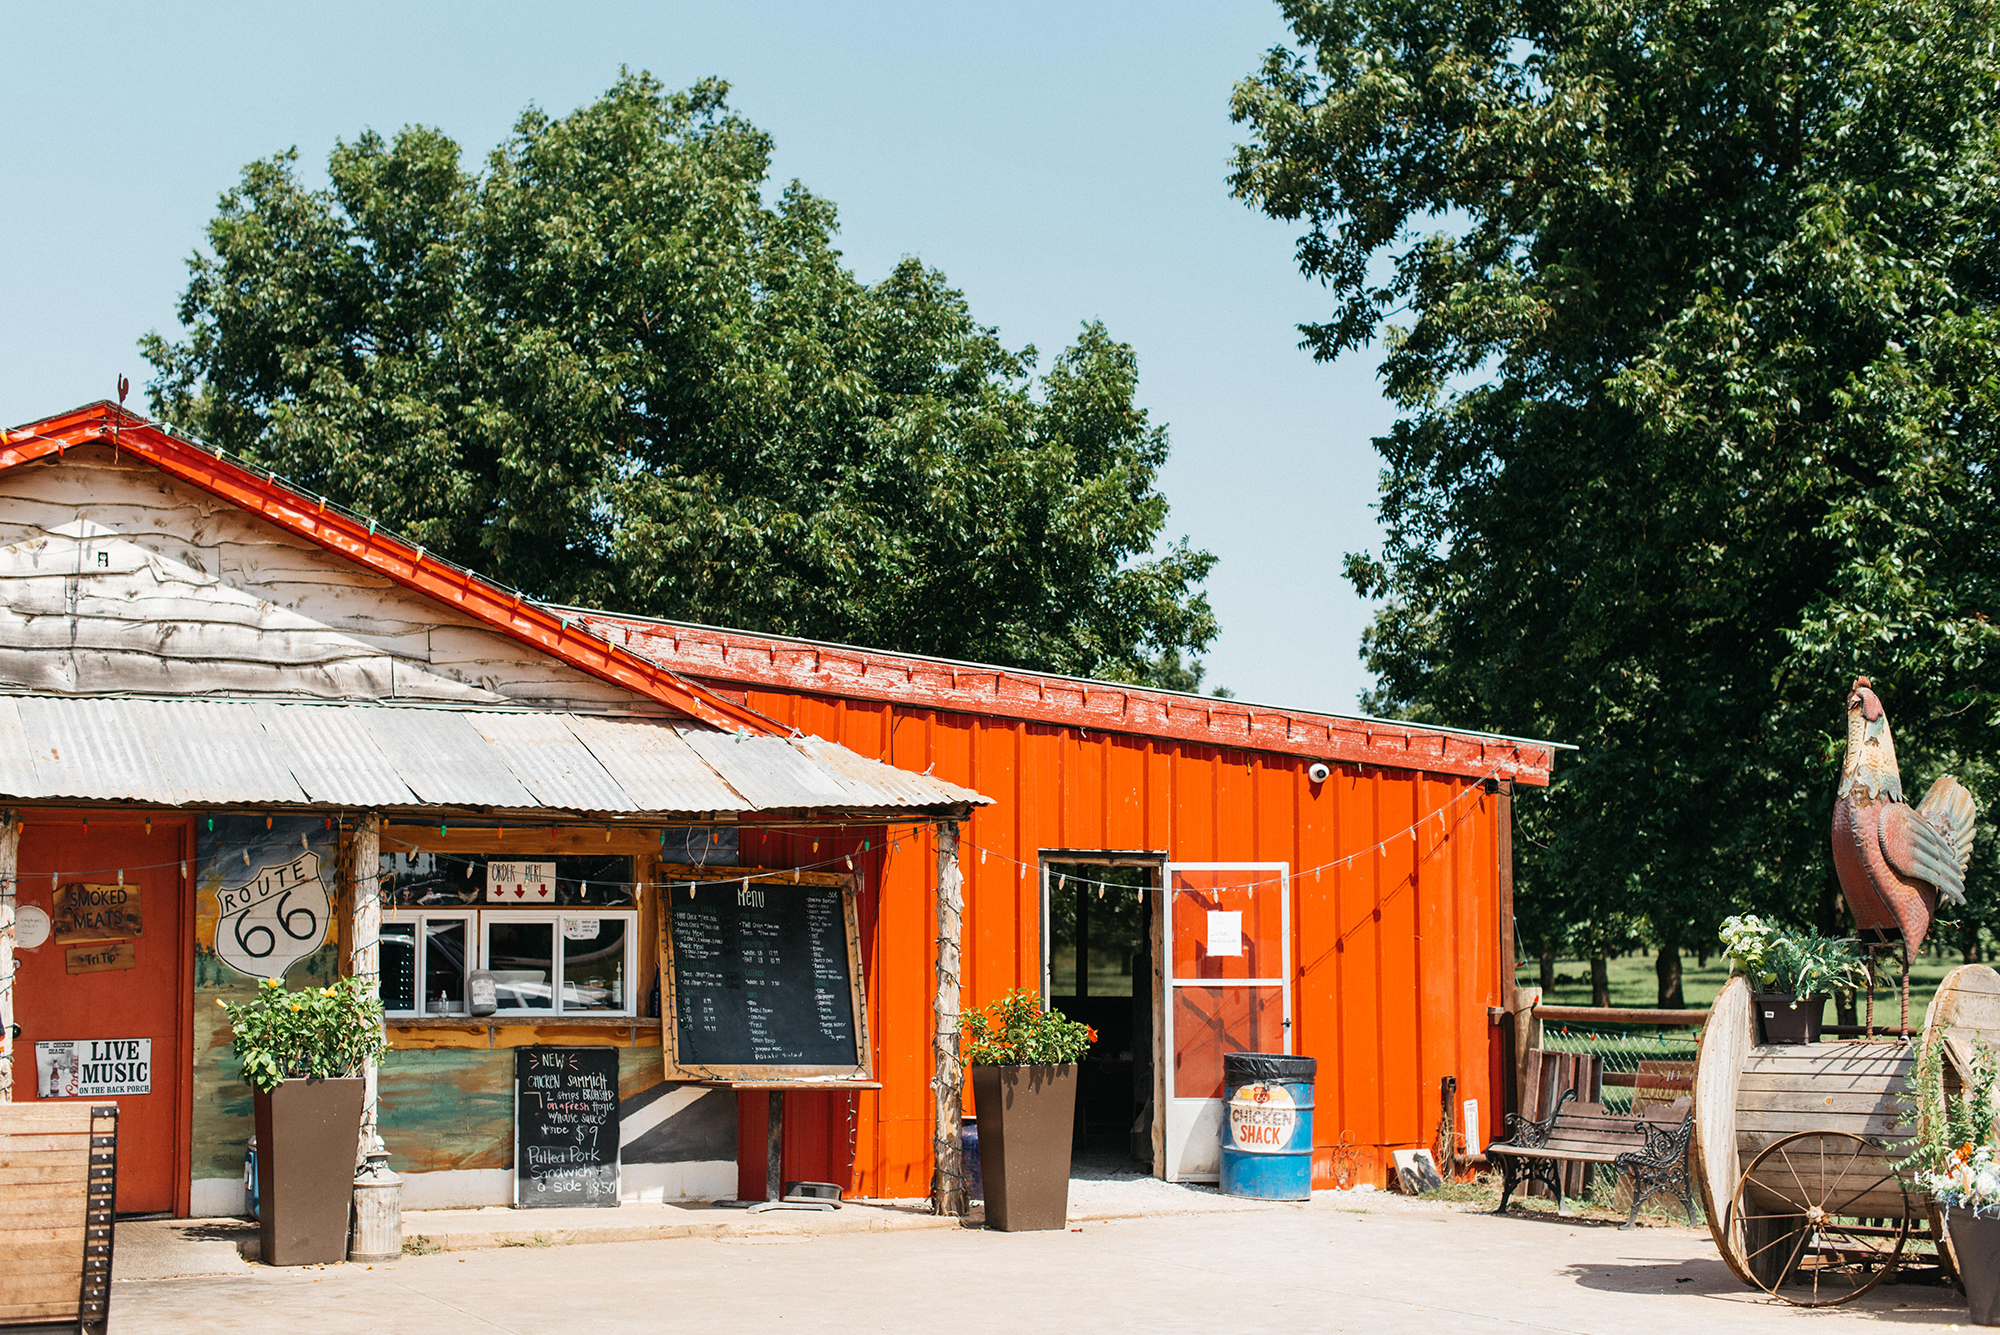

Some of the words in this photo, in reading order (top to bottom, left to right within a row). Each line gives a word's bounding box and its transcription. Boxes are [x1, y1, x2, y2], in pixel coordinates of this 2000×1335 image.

[491, 863, 516, 882] ORDER
[525, 864, 542, 883] HERE
[224, 861, 306, 912] ROUTE
[70, 889, 127, 908] SMOKED
[737, 888, 765, 908] Menu
[74, 910, 122, 929] MEATS
[234, 890, 317, 959] 66
[91, 1040, 140, 1061] LIVE
[541, 1053, 565, 1070] NEW
[81, 1061, 148, 1084] MUSIC
[79, 1086, 89, 1095] ON
[91, 1086, 105, 1094] THE
[106, 1085, 126, 1094] BACK
[126, 1084, 150, 1093] PORCH
[545, 1091, 554, 1102] 2
[1256, 1093, 1268, 1102] 66
[1232, 1109, 1293, 1126] CHICKEN
[1240, 1124, 1281, 1145] SHACK
[526, 1145, 566, 1165] Pulled
[569, 1145, 601, 1162] Pork
[530, 1163, 592, 1181] Sandwich
